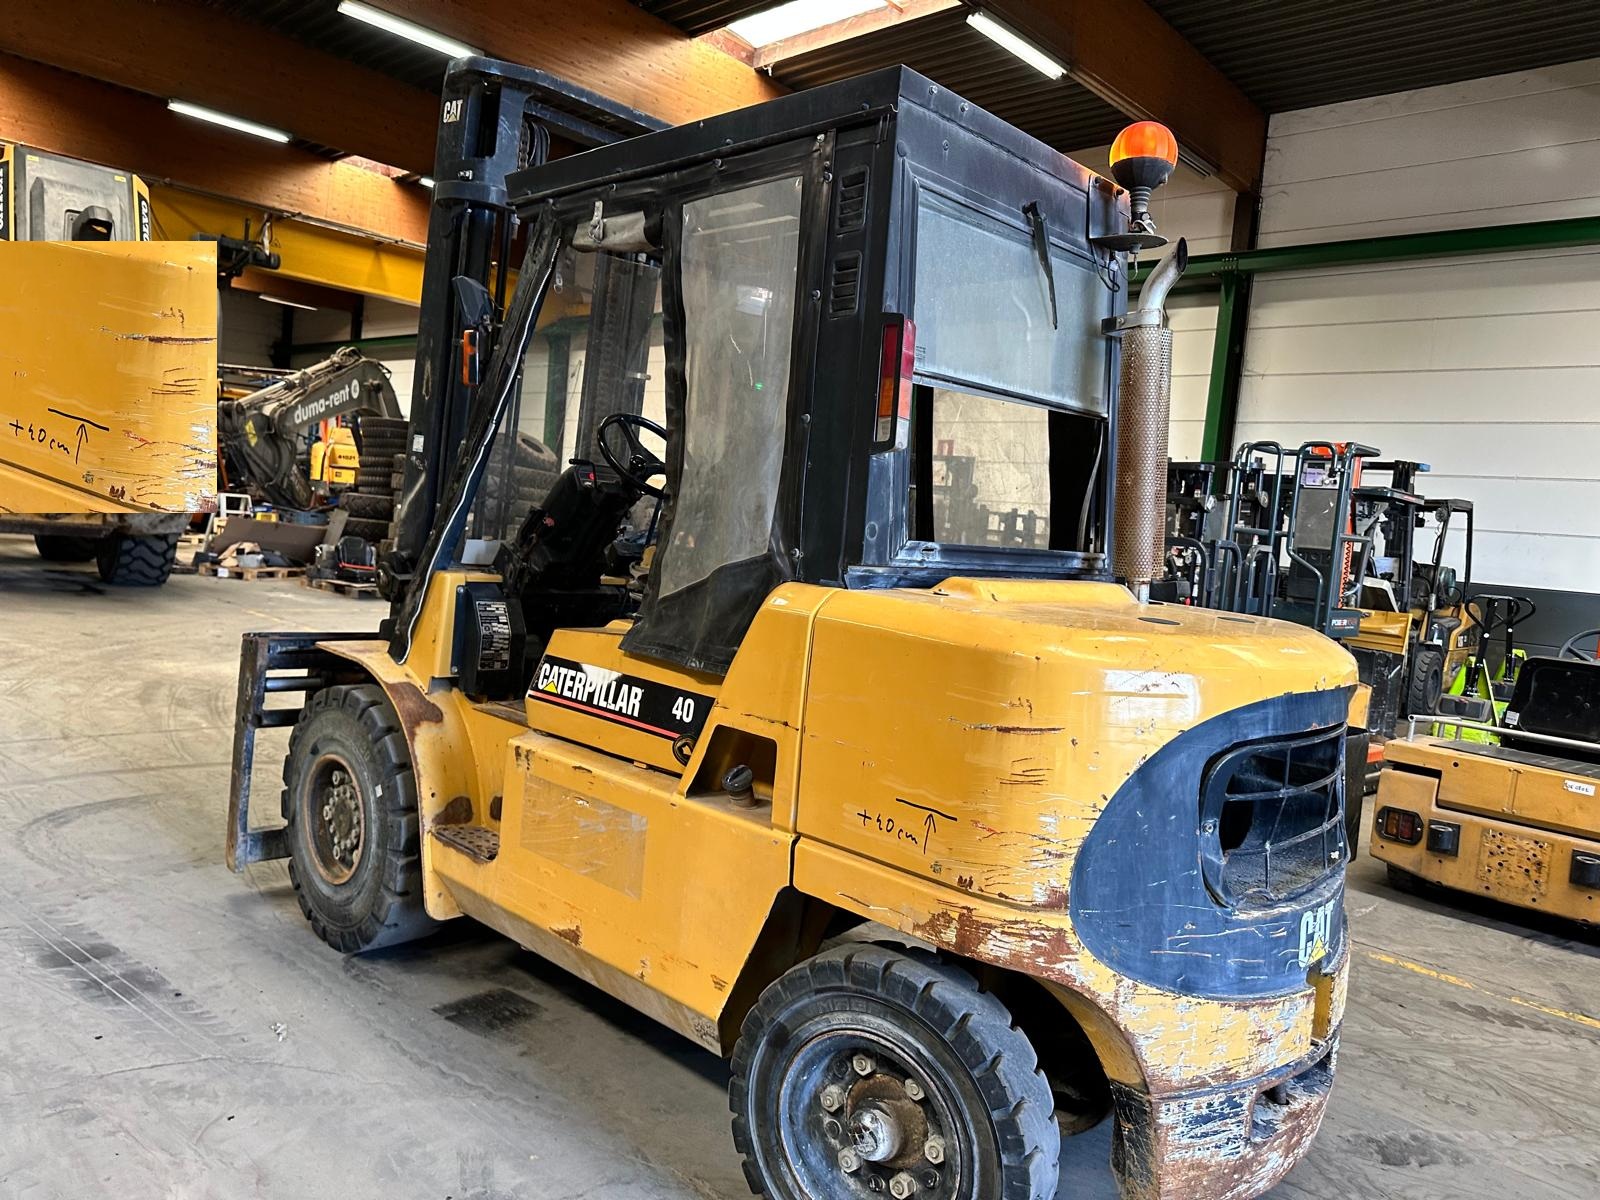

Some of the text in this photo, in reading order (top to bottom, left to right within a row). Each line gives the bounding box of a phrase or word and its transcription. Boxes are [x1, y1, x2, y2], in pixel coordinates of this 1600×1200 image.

[443, 99, 464, 123] CAT
[294, 384, 350, 424] duma-rent
[537, 662, 695, 723] CATERPILLAR 40
[1299, 899, 1336, 968] CAT
